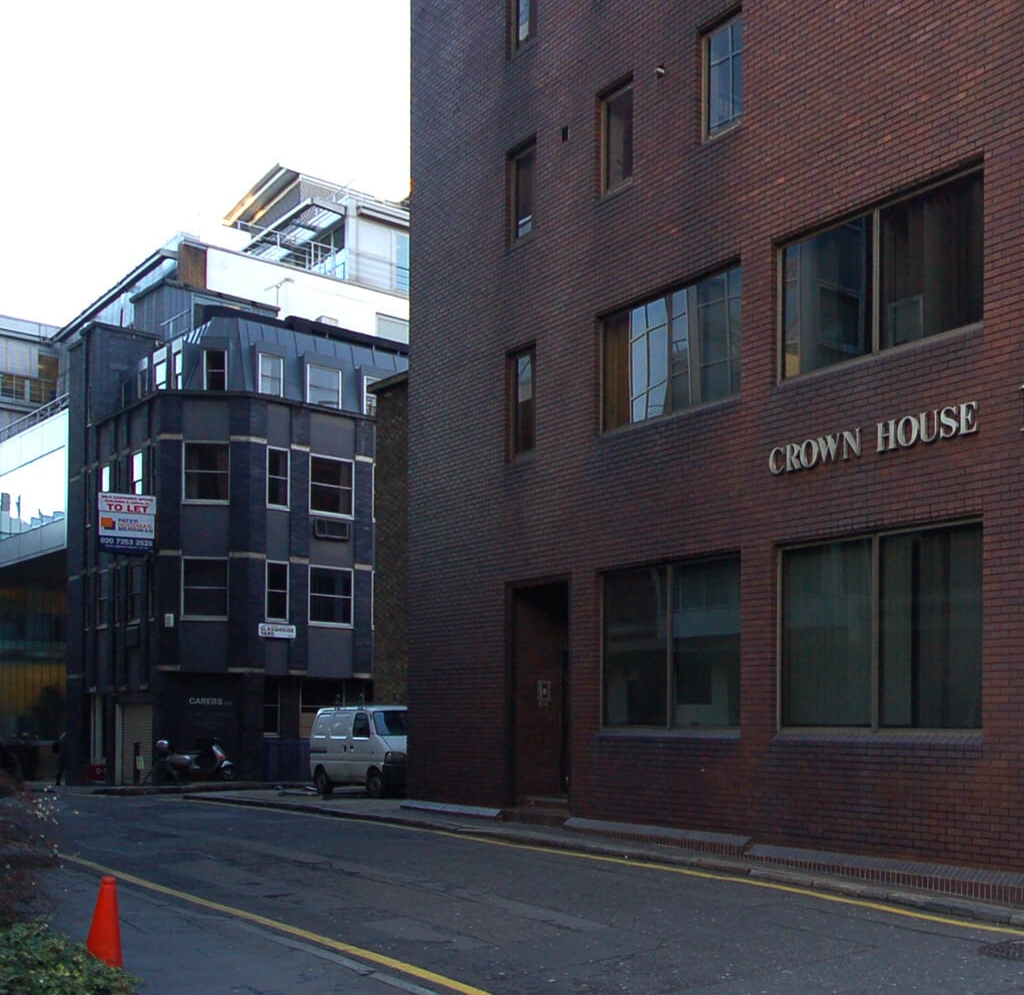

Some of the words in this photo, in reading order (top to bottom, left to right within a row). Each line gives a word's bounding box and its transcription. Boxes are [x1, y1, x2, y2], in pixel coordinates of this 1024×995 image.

[768, 427, 863, 476] CROWN
[876, 401, 979, 454] HOUSE
[107, 504, 123, 512] TO
[127, 505, 149, 513] LET
[189, 697, 224, 706] CARERS
